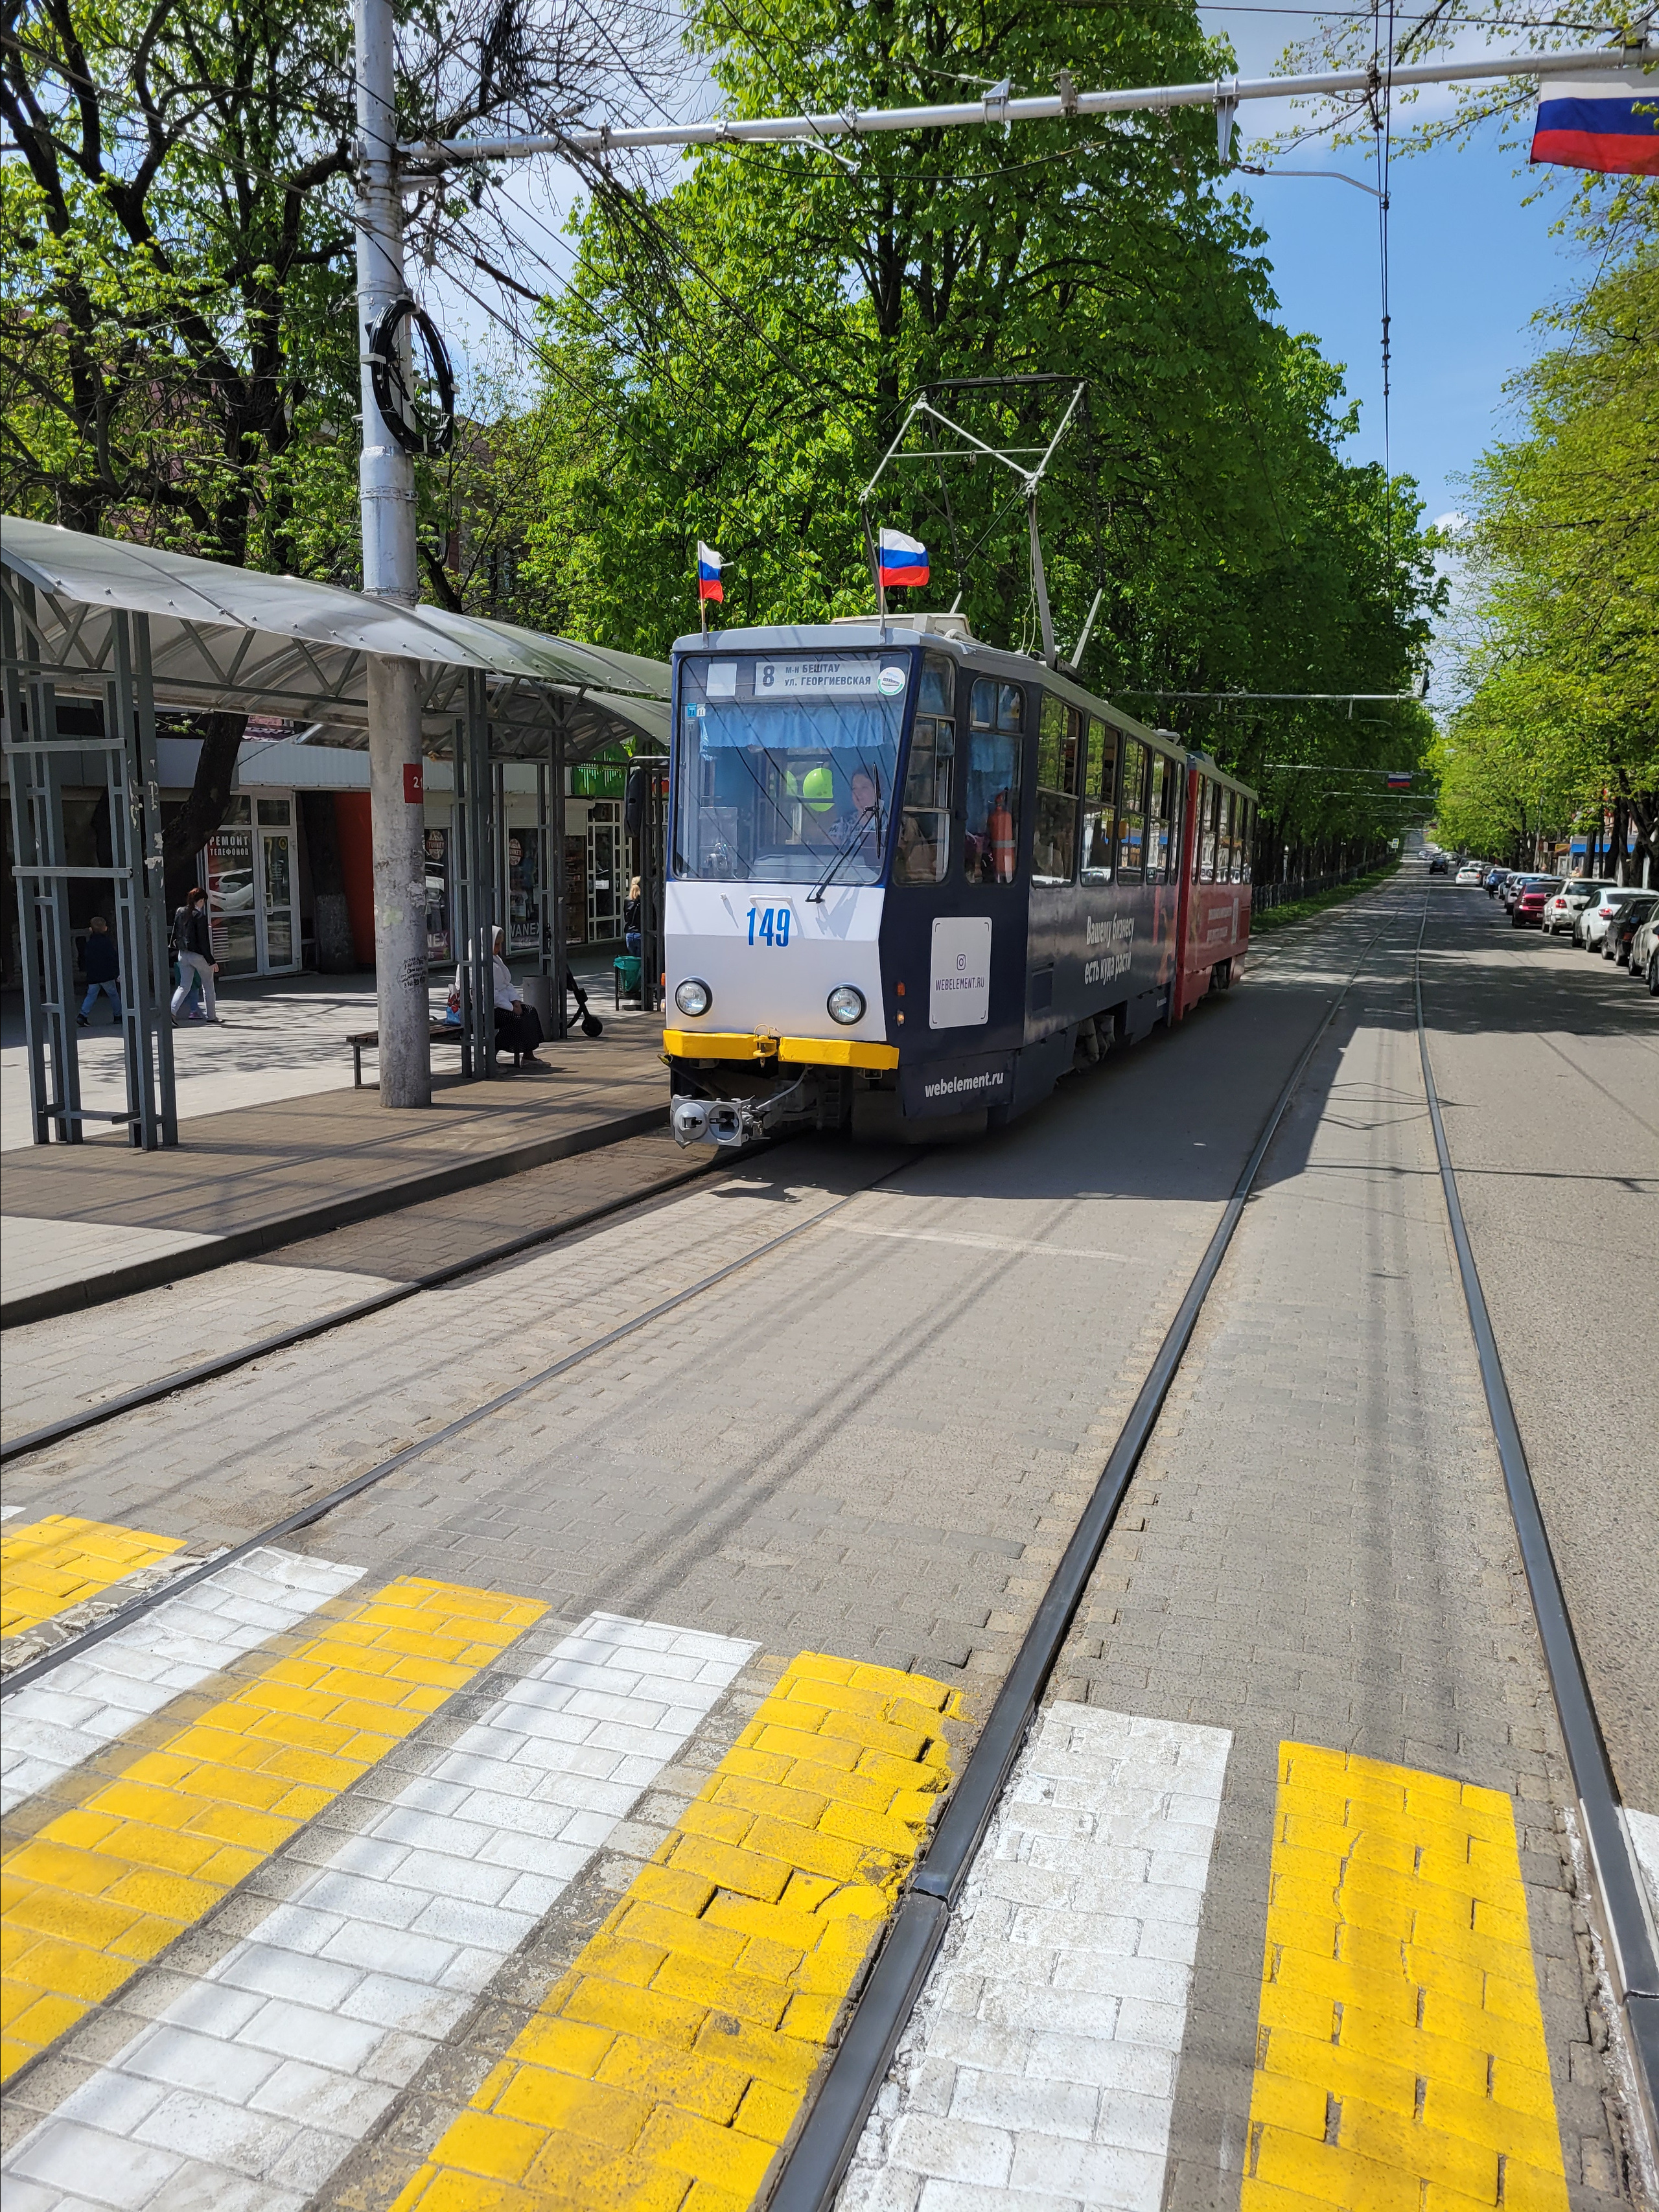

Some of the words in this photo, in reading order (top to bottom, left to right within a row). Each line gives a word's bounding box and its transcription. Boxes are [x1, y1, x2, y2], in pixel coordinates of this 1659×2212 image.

[763, 665, 775, 687] 8
[802, 664, 841, 673] БЕШТАУ
[801, 676, 871, 686] ГЕОРГИЕВСКАЯ
[209, 836, 249, 846] РЕМОНТ
[210, 848, 249, 856] ТЕЛЕФОНОВ
[747, 907, 791, 947] 149
[1086, 916, 1112, 949] Вашему
[1113, 912, 1135, 944] бизнесу
[1085, 962, 1100, 985] есть
[1100, 955, 1115, 986] куда
[1115, 951, 1131, 982] расти
[935, 977, 985, 991] WEBELEMENT.RU
[925, 1072, 1004, 1098] webelement.ru
